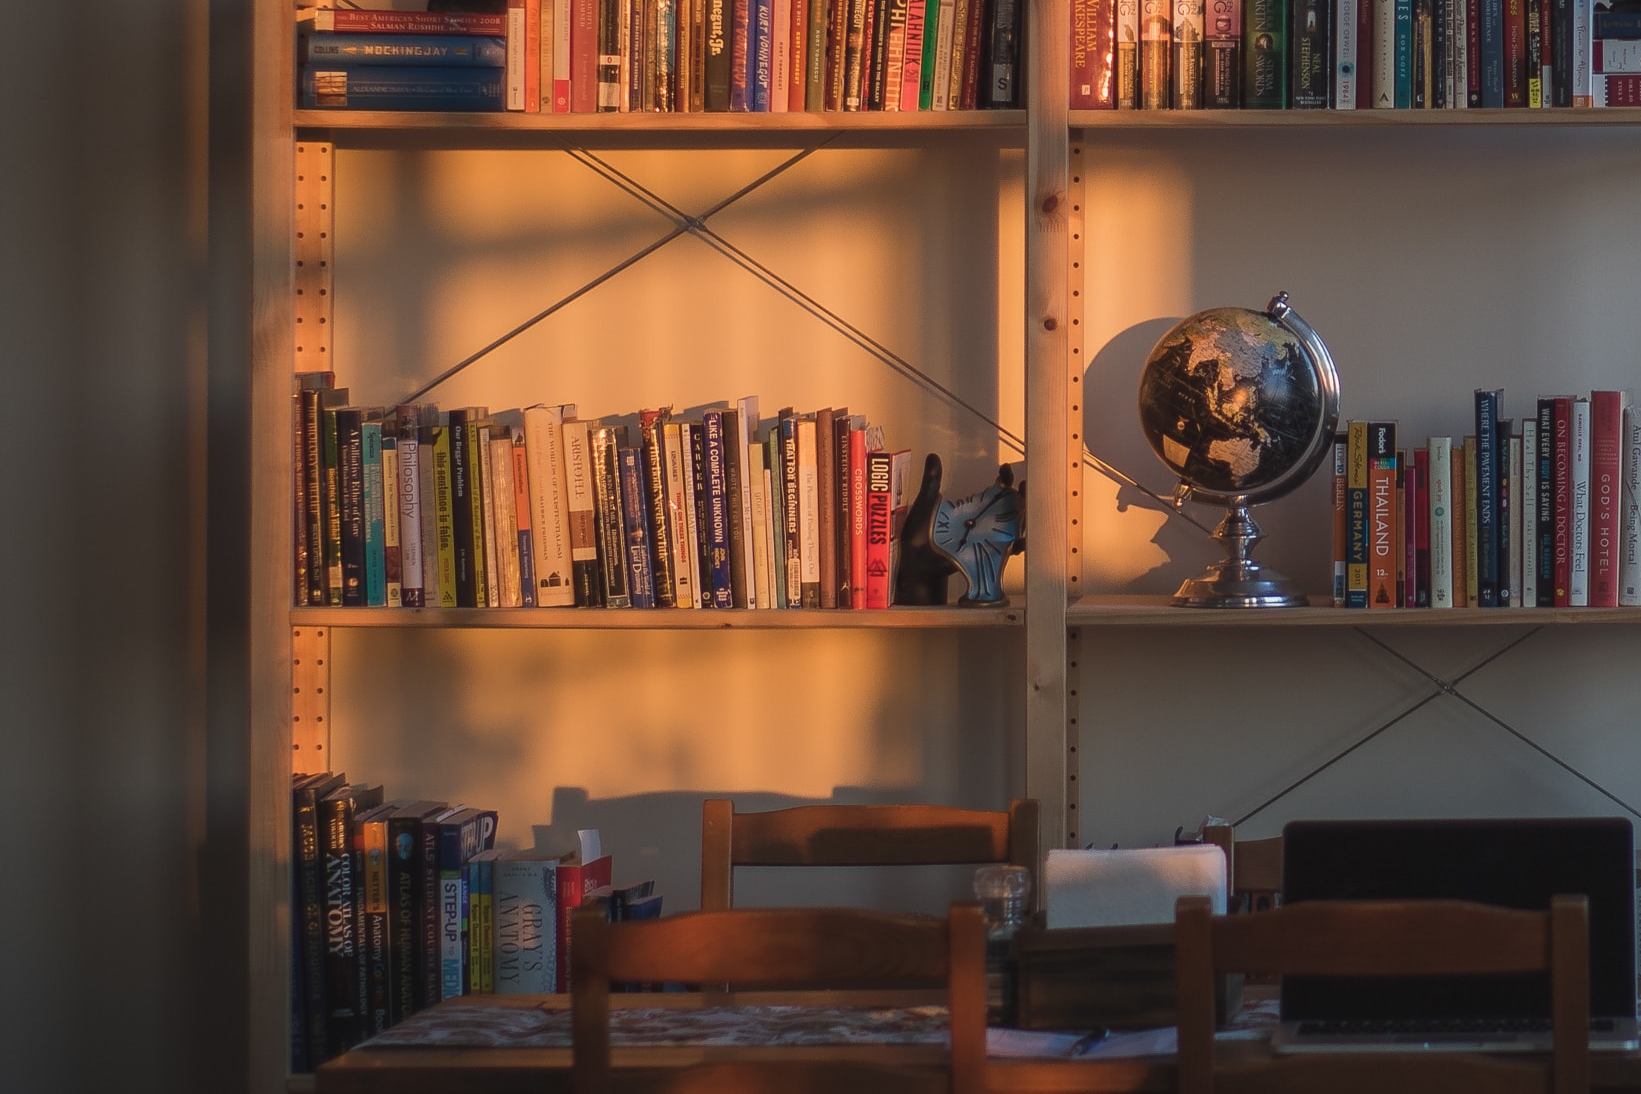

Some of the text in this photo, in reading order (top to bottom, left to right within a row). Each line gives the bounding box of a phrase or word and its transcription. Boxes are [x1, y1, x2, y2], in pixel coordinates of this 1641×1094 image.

[314, 46, 448, 56] COLLINS MOCKINGJAY
[709, 39, 723, 55] Jr.
[757, 5, 769, 88] KURT VONNEGUT
[1301, 38, 1311, 89] STEPHENSON
[1312, 53, 1320, 74] NEAL
[1511, 25, 1519, 42] Indu
[1256, 55, 1265, 96] SWORDS
[455, 443, 463, 466] Beggar
[548, 443, 556, 475] WORLDS
[571, 435, 585, 500] ARISTOTLE
[786, 438, 795, 460] THAI
[1354, 427, 1363, 449] Rick
[1481, 399, 1491, 524] WHERE THE PAVEMENT ENDS
[1541, 408, 1550, 522] WHAT EVERY BODY IS SAYING
[401, 443, 416, 519] Philosophy
[456, 468, 464, 497] Problem
[551, 477, 558, 487] OF
[708, 419, 723, 543] LIKE A COMPLETE UNKNOWN
[786, 462, 795, 481] FOR
[855, 468, 863, 535] CROSSWORDS
[870, 458, 889, 545] LOGIC PUZZLES
[1336, 477, 1345, 513] BERLIN
[1375, 427, 1389, 556] Fodor's THAILAND
[1557, 419, 1567, 564] ON BECOMING A DOCTOR
[1626, 424, 1641, 565] Atul Gawande Being Mortal
[552, 489, 562, 559] EXISTENTIALISM
[787, 482, 797, 533] BEGINNERS
[1353, 490, 1363, 561] GERMANY
[1599, 473, 1611, 575] GOD'S HOTEL
[326, 852, 343, 958] ANATOMY
[340, 852, 353, 957] COLOR ATLAS OF
[372, 871, 380, 911] NETTER'S
[445, 883, 457, 942] STEP-UP
[355, 887, 368, 1016] FUNDAMENTALS OF PATHOLOGY
[372, 915, 383, 962] Anatomy
[449, 946, 454, 955] TO
[499, 891, 520, 984] ANATOMY
[523, 904, 543, 971] GRAY'S
